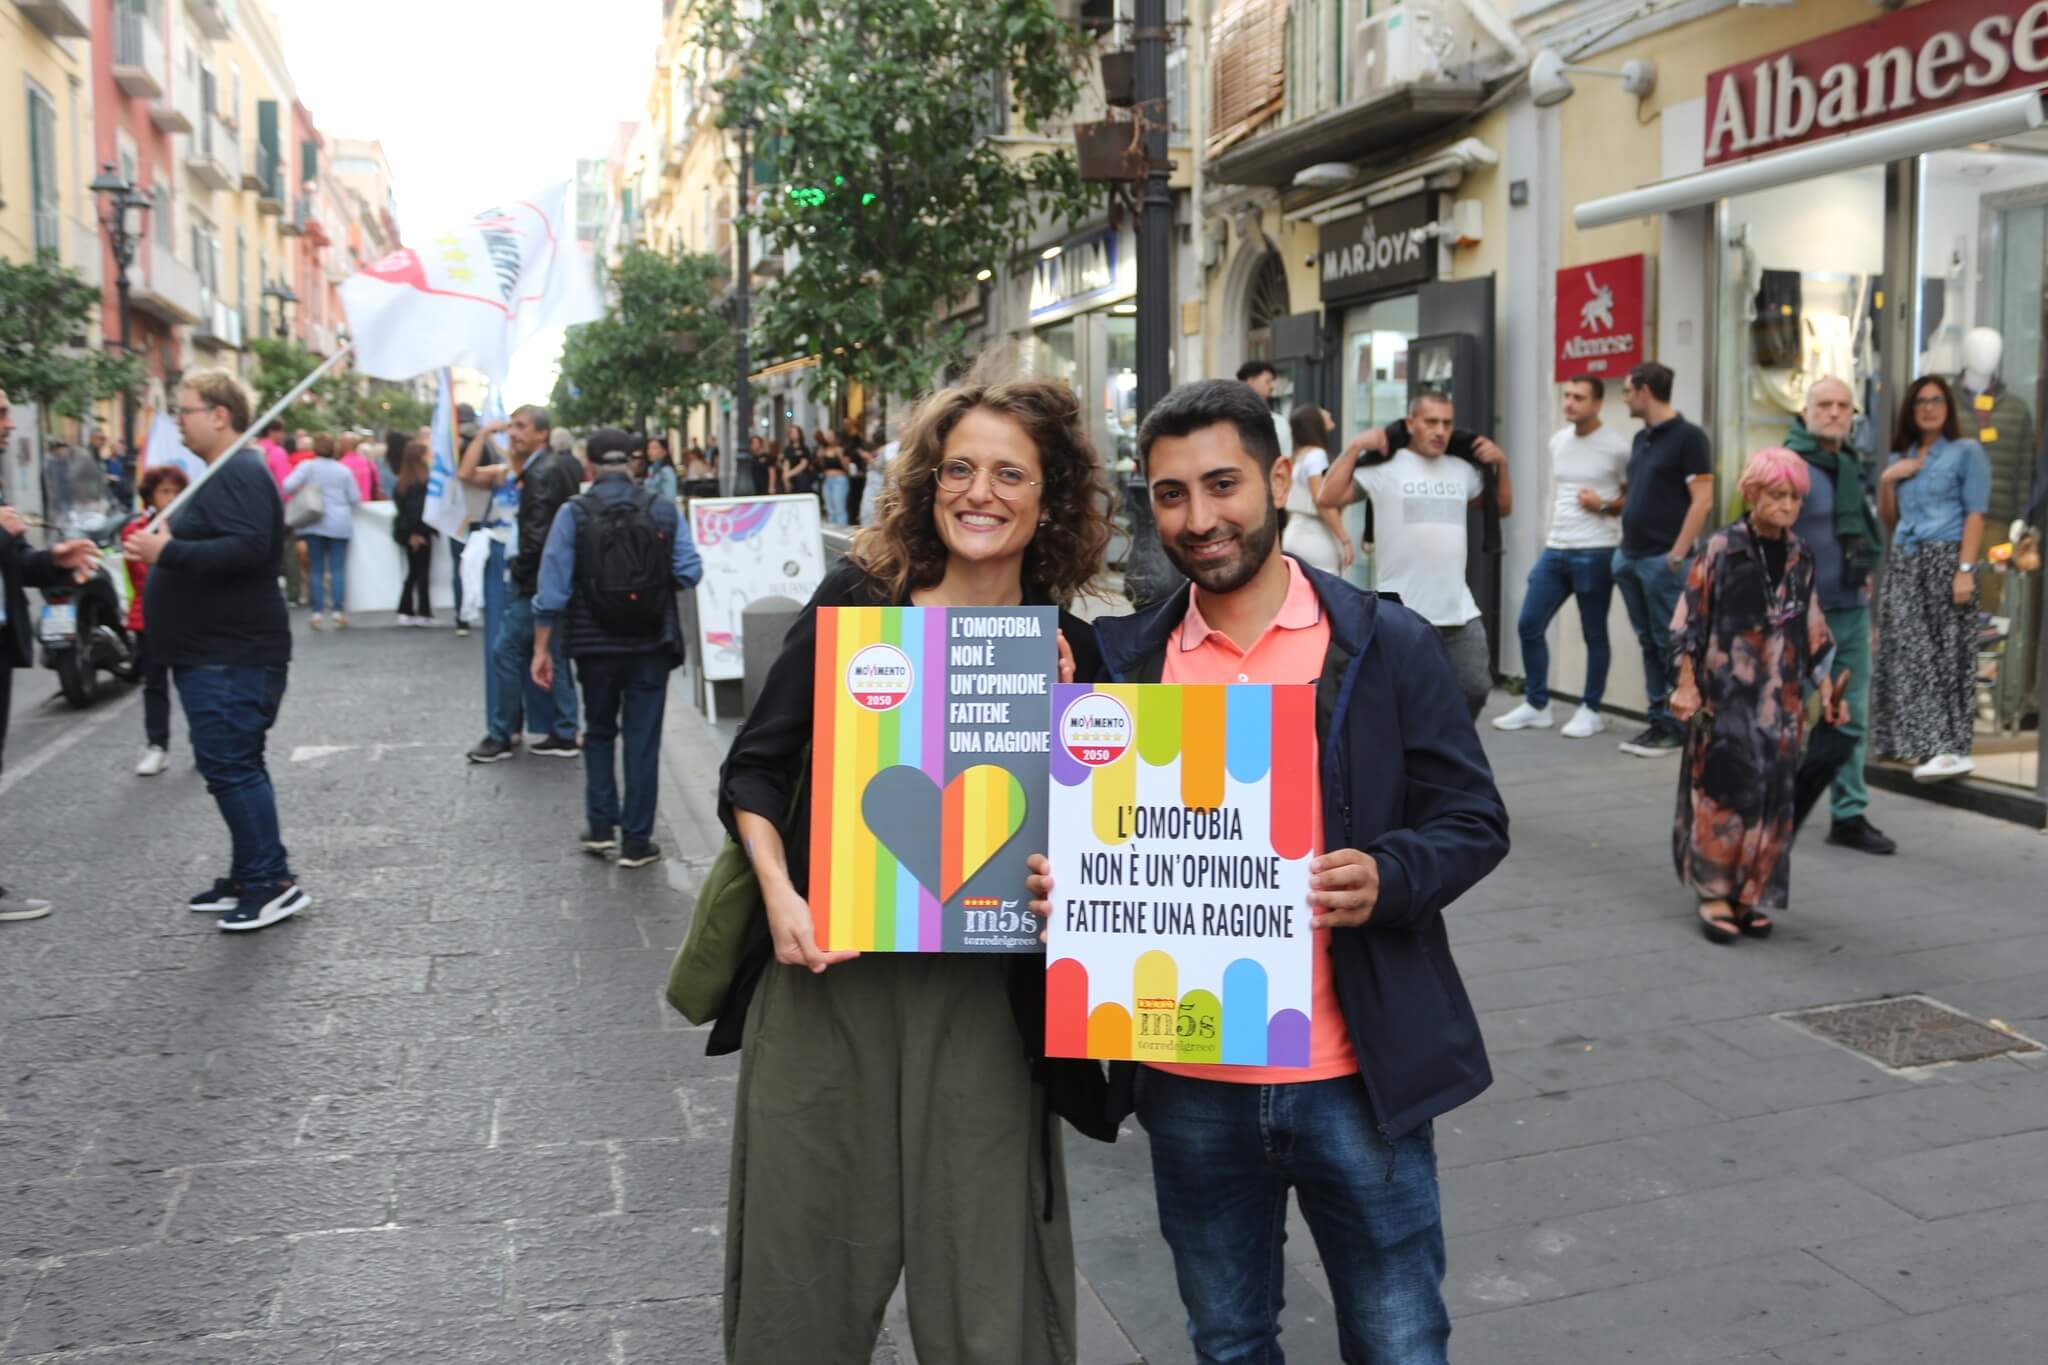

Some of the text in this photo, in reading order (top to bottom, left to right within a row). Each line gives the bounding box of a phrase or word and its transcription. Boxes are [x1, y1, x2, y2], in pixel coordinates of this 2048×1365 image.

[1706, 2, 2048, 158] Albanese
[1323, 228, 1420, 281] MARJOYA
[951, 616, 1042, 638] L'OMOFOBIA
[951, 639, 995, 667] NON È
[951, 673, 1047, 695] UN'OPINIONE
[866, 695, 893, 706] 2050
[950, 702, 1010, 724] FATTENE
[1070, 714, 1125, 729] MOVIMENTO
[950, 731, 1050, 752] UNA RAGIONE
[1082, 749, 1110, 760] 2050
[1117, 805, 1243, 841] L'OMOFOBIA
[1080, 843, 1280, 890] NON È UN'OPINIONE
[963, 900, 1038, 934] m5s
[1066, 899, 1294, 938] FATTENE UNA RAGIONE
[963, 935, 1038, 948] torredelgreco
[1137, 1003, 1216, 1039] m5s
[1137, 1039, 1216, 1052] torredelgreco
